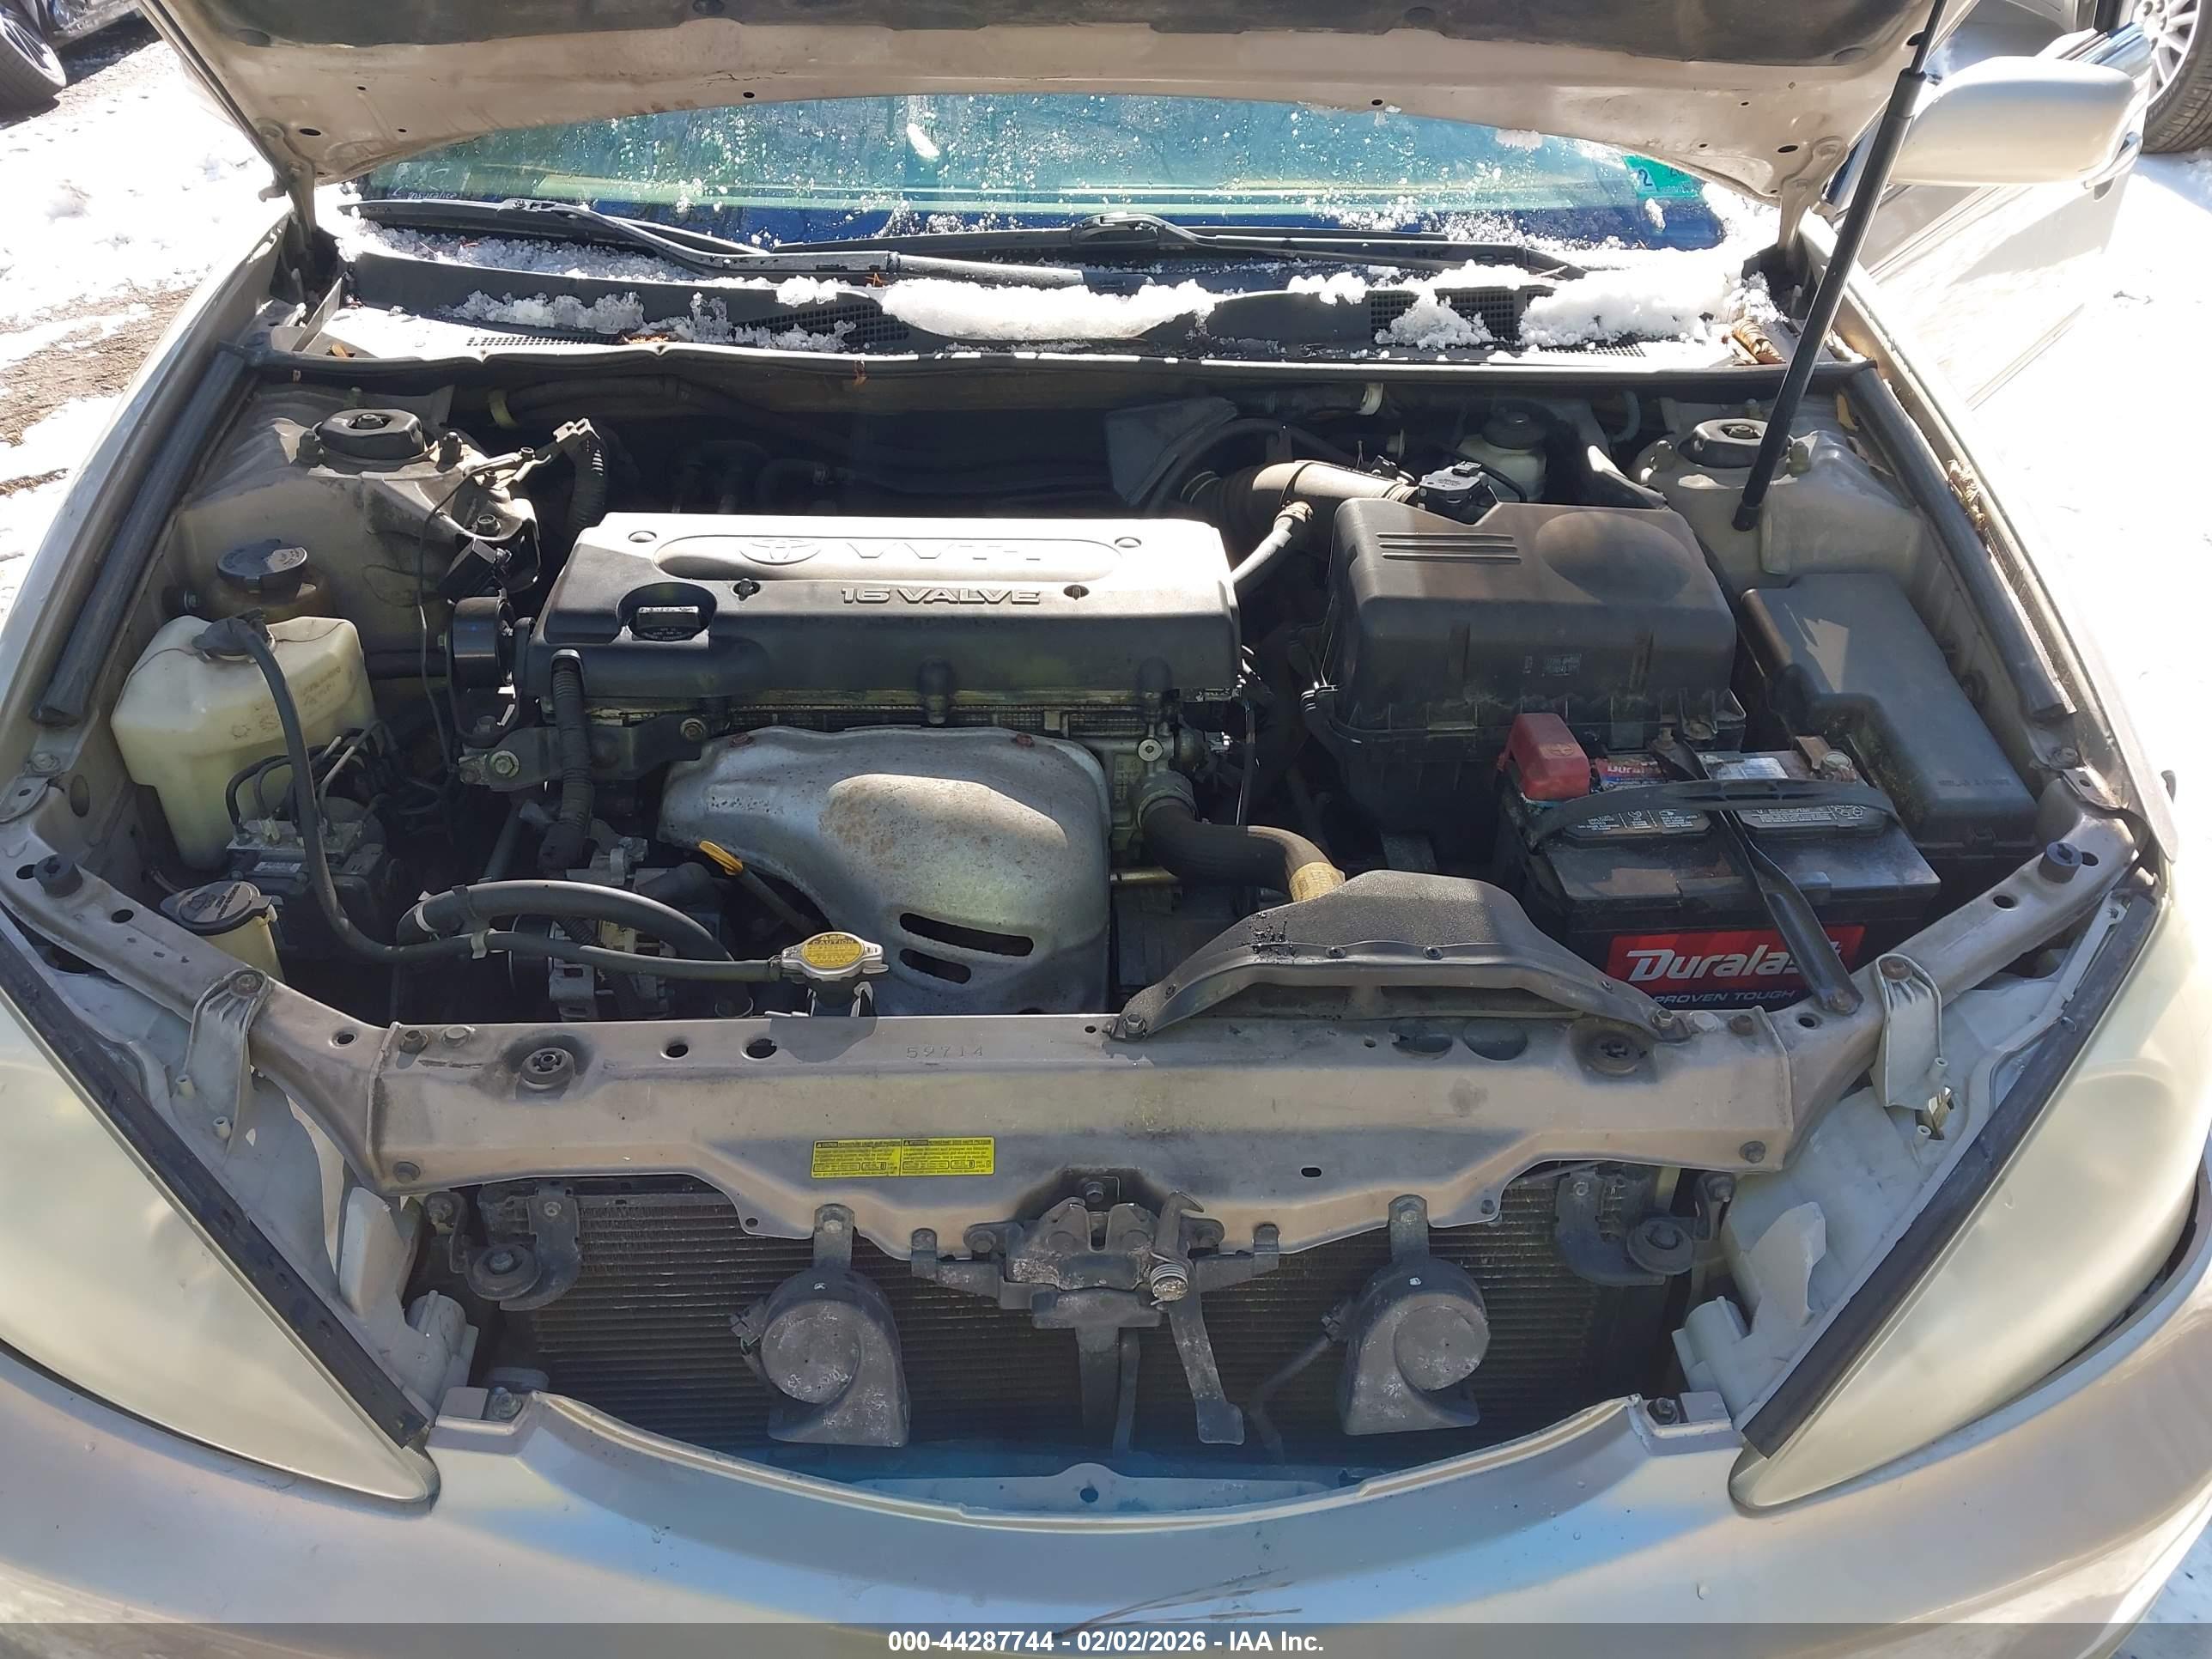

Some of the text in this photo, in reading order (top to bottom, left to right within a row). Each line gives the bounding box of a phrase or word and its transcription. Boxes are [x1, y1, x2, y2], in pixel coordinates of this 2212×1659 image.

[842, 588, 1042, 605] 16 VALVE
[1652, 989, 1796, 1004] PROVEN TOUGH
